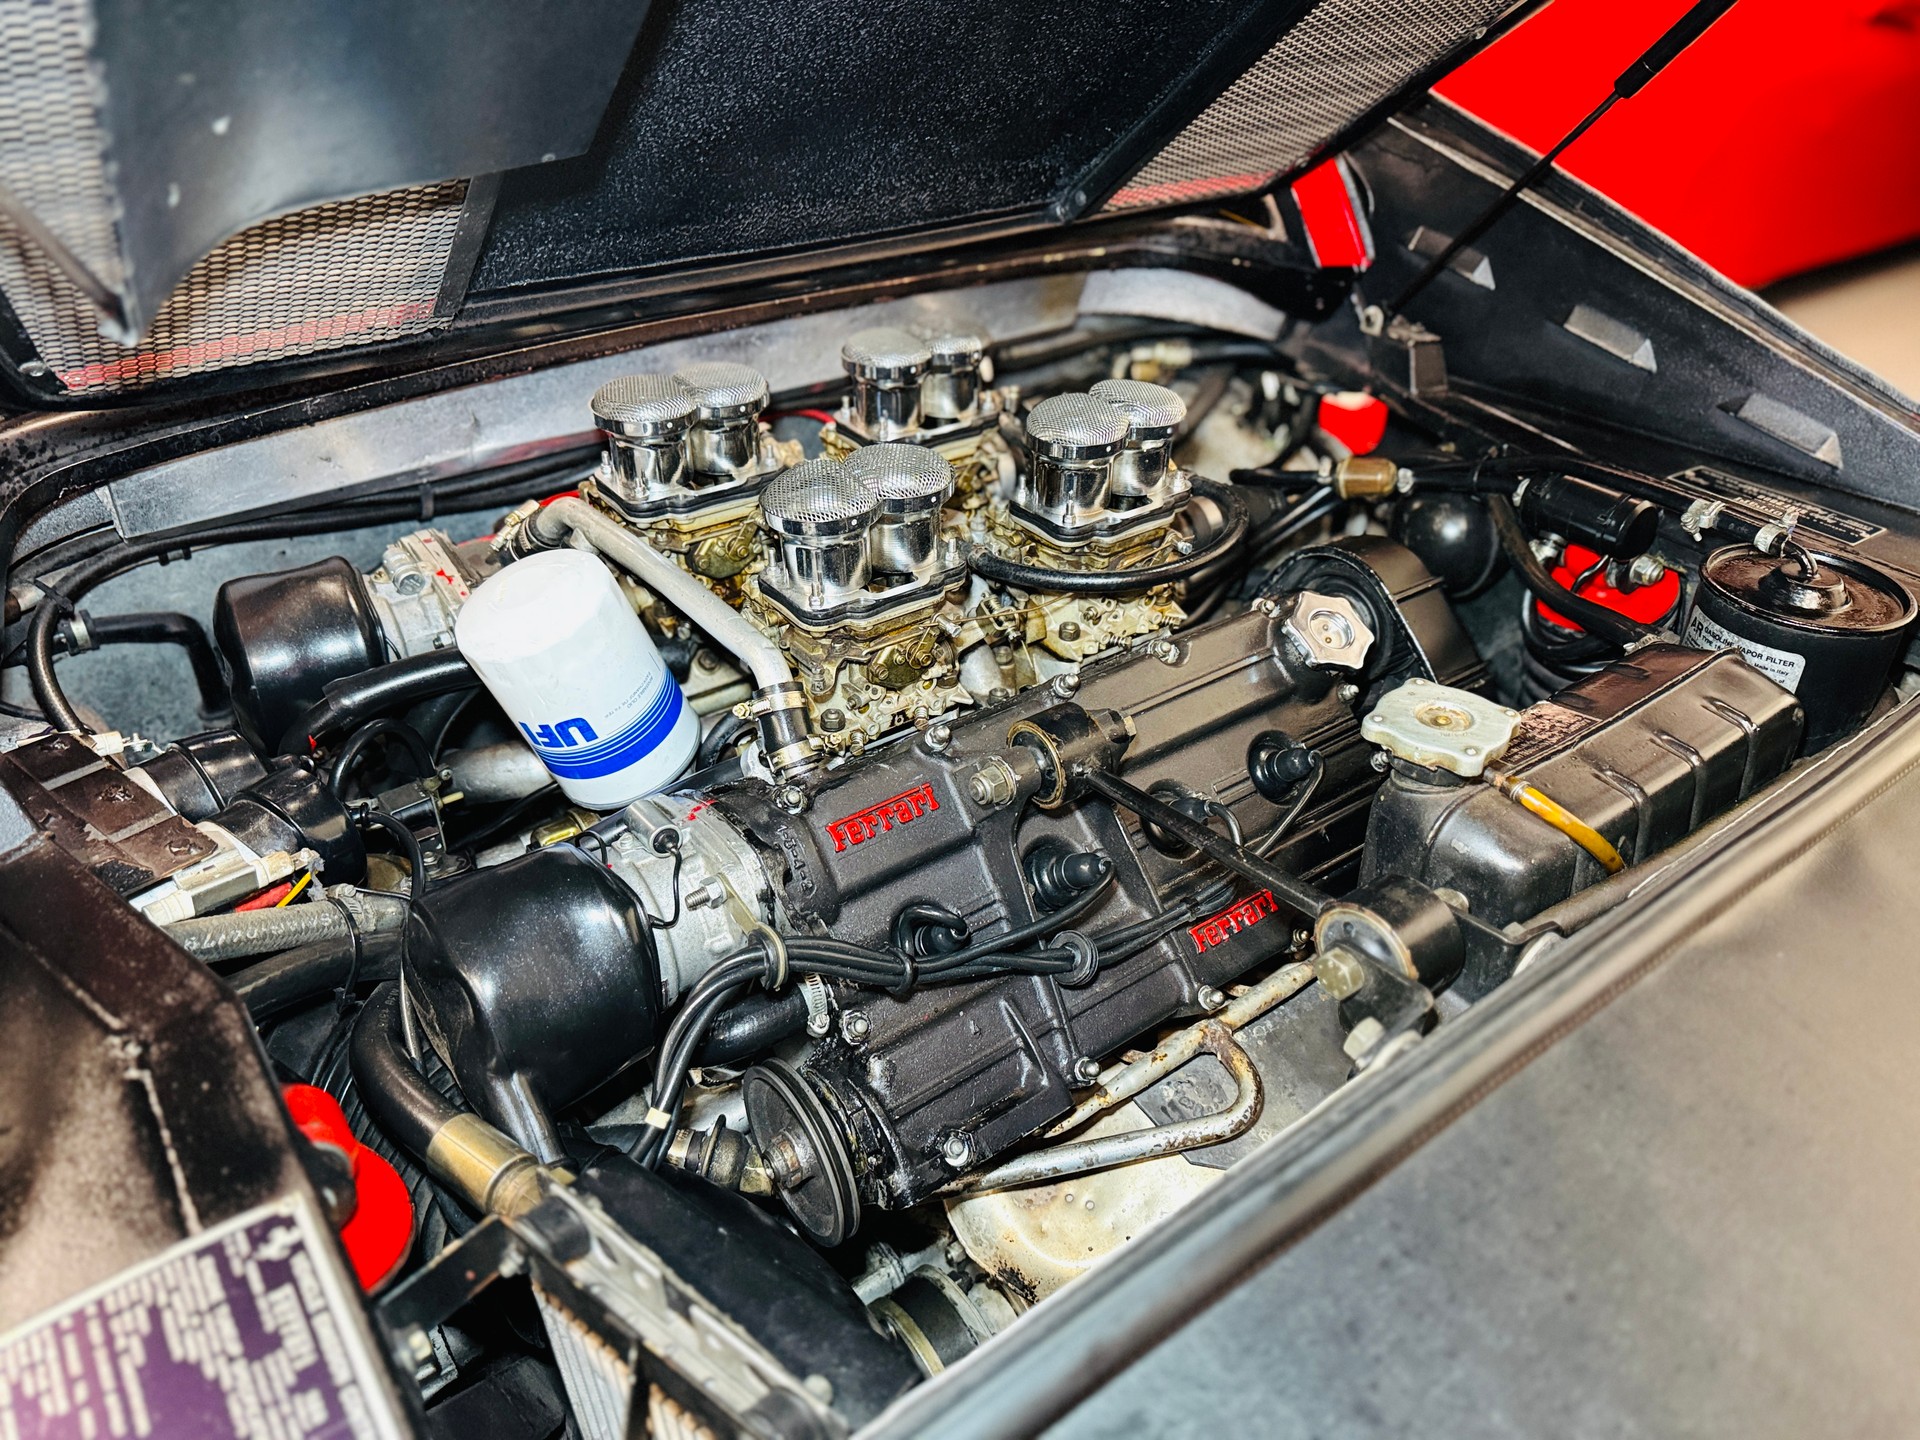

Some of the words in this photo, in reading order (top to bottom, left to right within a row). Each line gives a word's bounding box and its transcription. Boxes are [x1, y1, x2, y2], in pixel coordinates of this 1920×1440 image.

[1704, 626, 1734, 647] GASOLINE
[1737, 645, 1763, 660] VAPOR
[1765, 655, 1795, 668] FILTER
[518, 717, 599, 747] UFI
[825, 782, 940, 853] Ferrari
[1188, 888, 1278, 954] Ferrari
